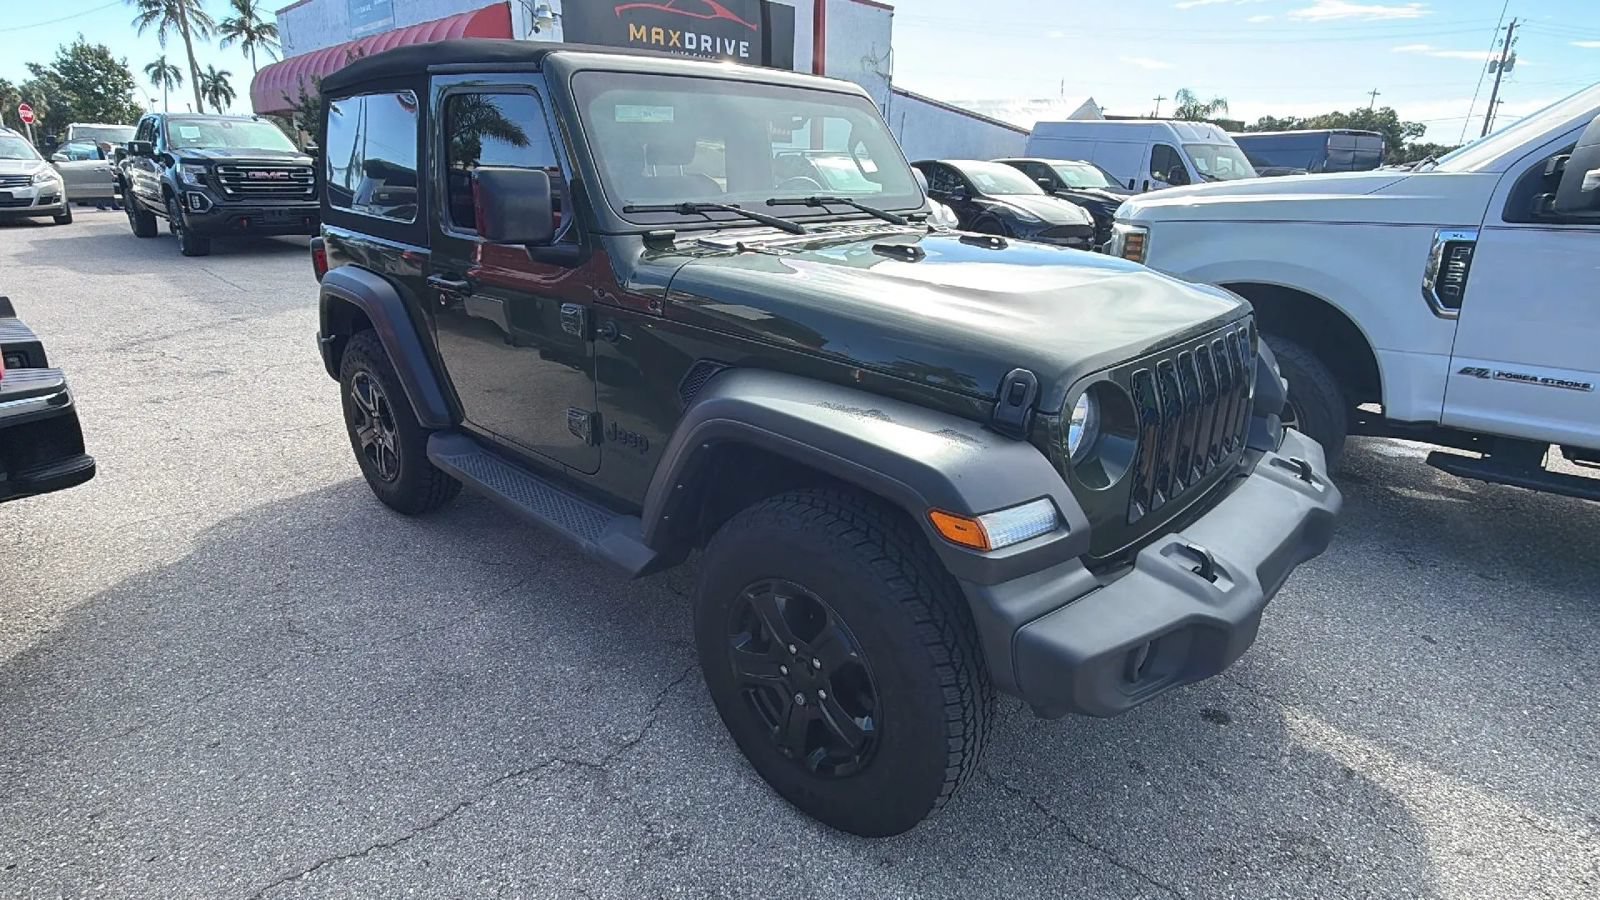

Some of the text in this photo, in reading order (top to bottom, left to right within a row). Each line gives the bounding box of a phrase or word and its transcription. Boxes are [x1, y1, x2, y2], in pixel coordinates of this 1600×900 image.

[629, 23, 749, 58] MAXDRIVE
[248, 171, 289, 180] GMC
[1497, 370, 1538, 382] POWER
[1541, 377, 1592, 388] STROKE
[607, 421, 649, 454] Jeep
